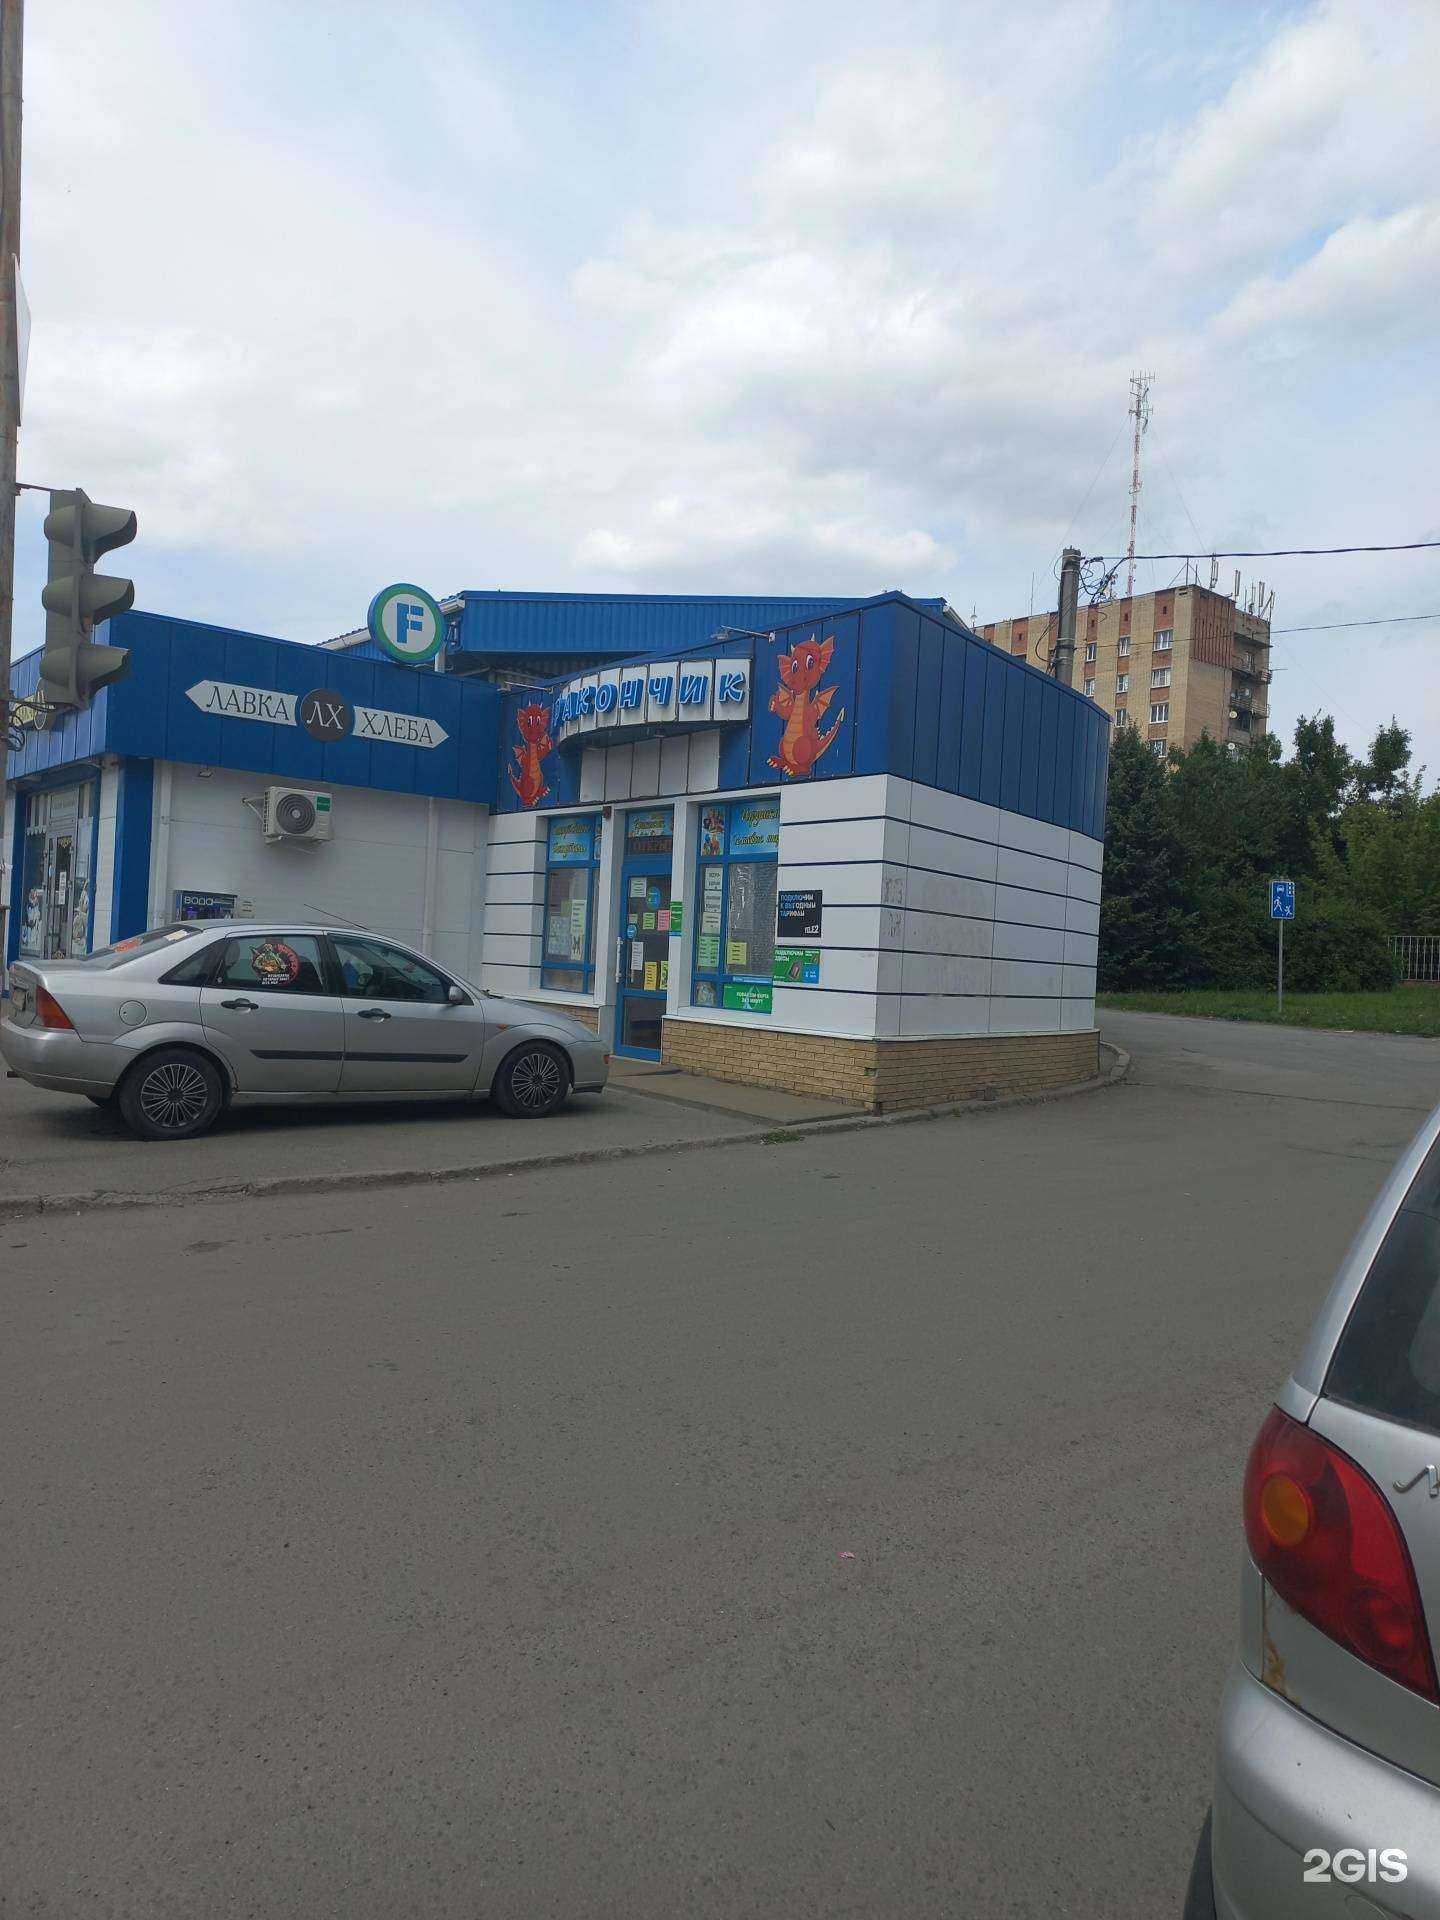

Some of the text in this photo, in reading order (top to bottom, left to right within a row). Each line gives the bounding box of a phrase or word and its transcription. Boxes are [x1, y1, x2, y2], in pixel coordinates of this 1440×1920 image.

[395, 602, 424, 643] F
[206, 685, 434, 744] ЛАВКА ЛХ ХЛЕБА
[551, 671, 746, 727] РАКОНЧИК
